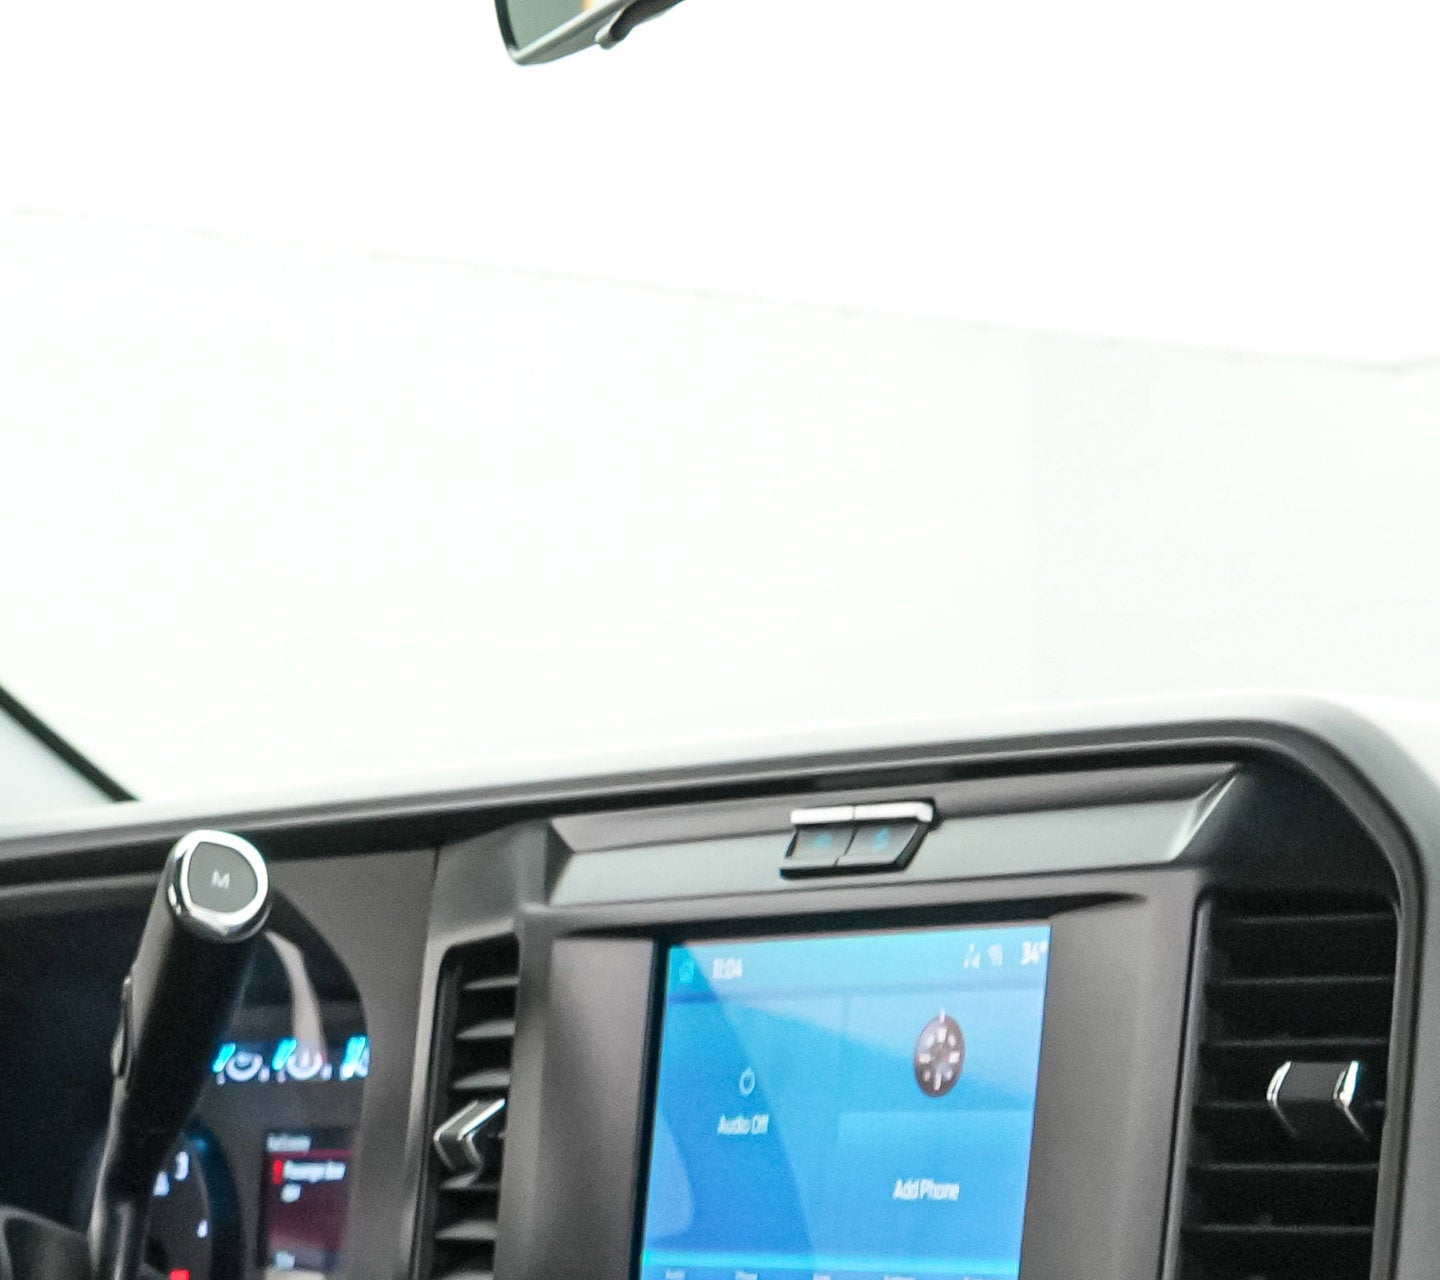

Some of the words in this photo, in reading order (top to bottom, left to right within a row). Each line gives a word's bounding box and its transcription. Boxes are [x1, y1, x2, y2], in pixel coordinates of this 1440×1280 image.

[211, 869, 231, 890] M
[892, 1178, 919, 1200] Add
[920, 1179, 959, 1201] Phone
